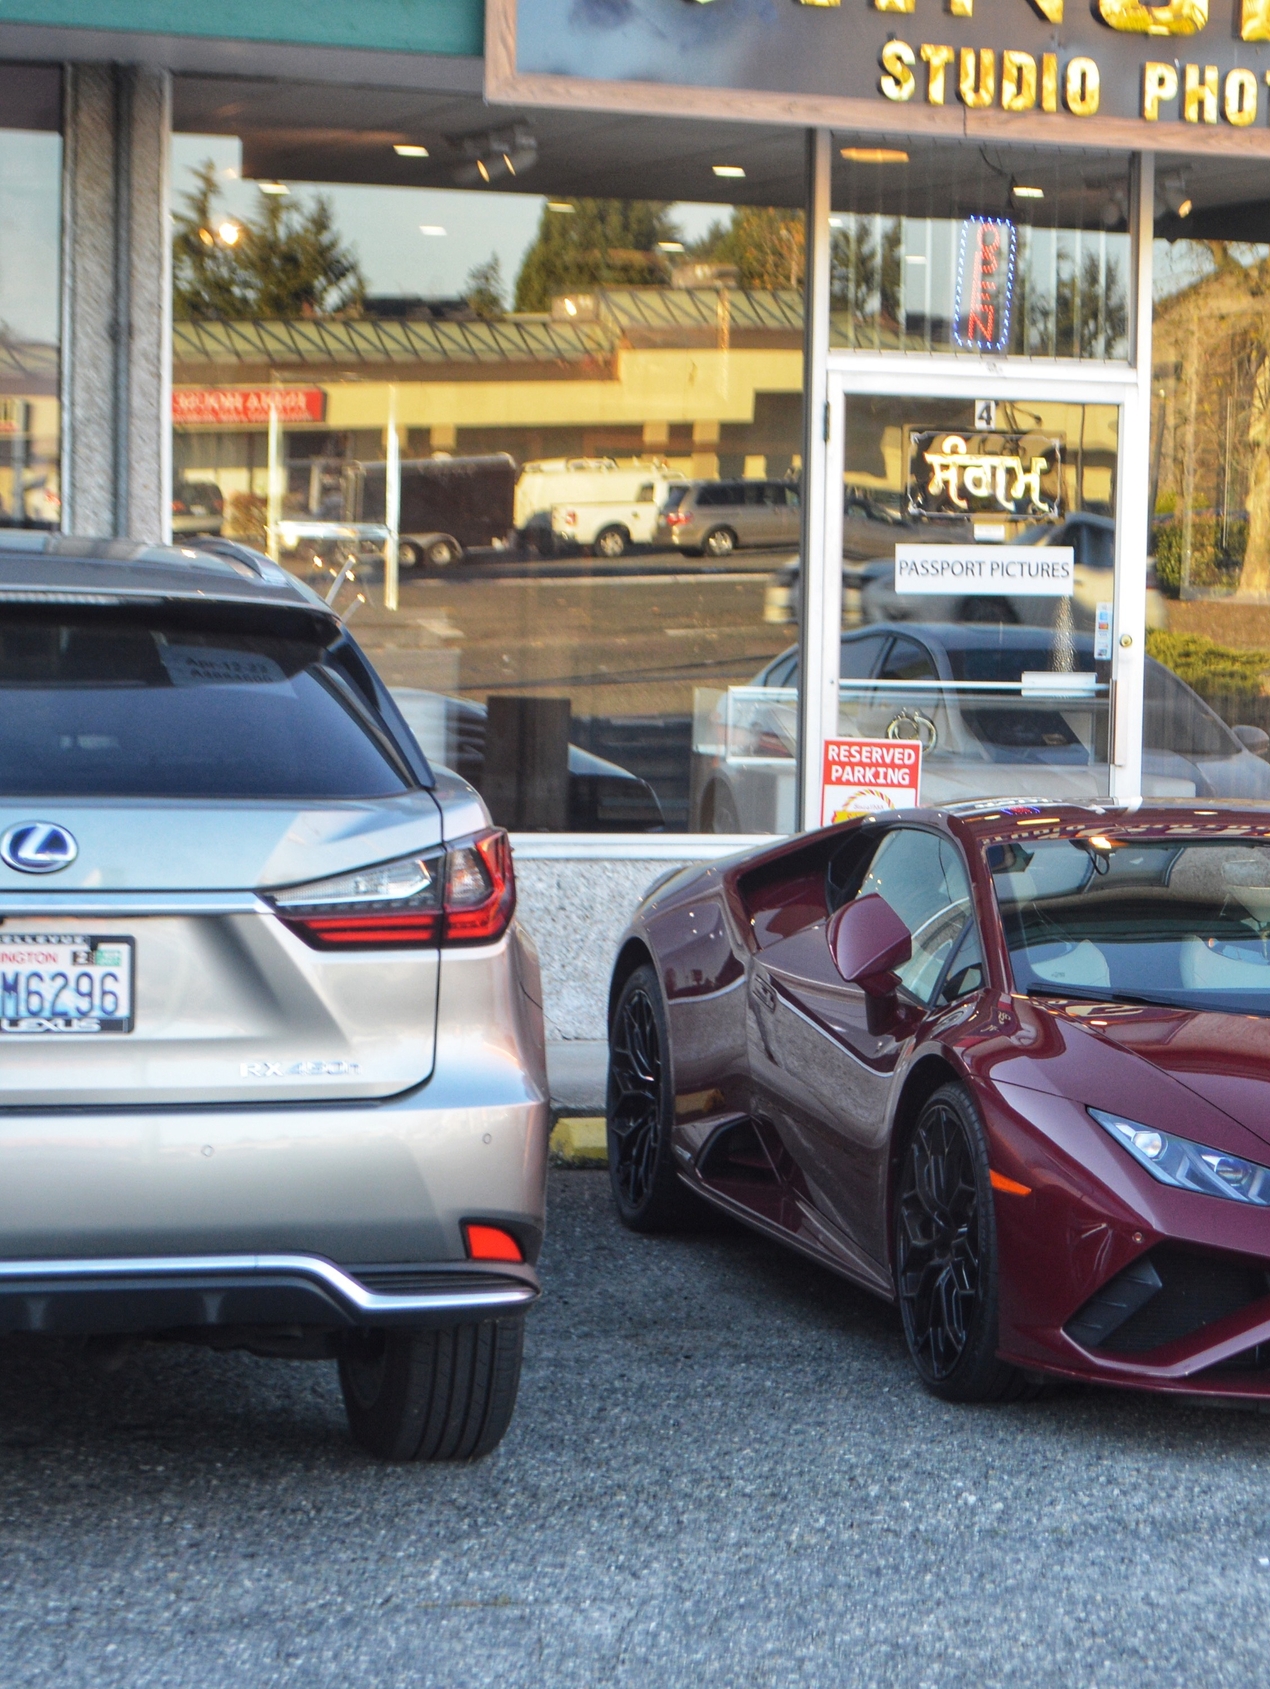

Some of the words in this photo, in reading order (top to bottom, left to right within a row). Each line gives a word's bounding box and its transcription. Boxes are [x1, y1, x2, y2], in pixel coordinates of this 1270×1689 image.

[880, 39, 1100, 116] STUDIO
[976, 401, 993, 426] 4
[898, 559, 985, 579] PASSPORT
[990, 560, 1070, 579] PICTURES
[827, 744, 917, 766] RESERVED
[831, 764, 911, 786] PARKING
[0, 1018, 102, 1032] LEXUS
[239, 1061, 284, 1078] RX
